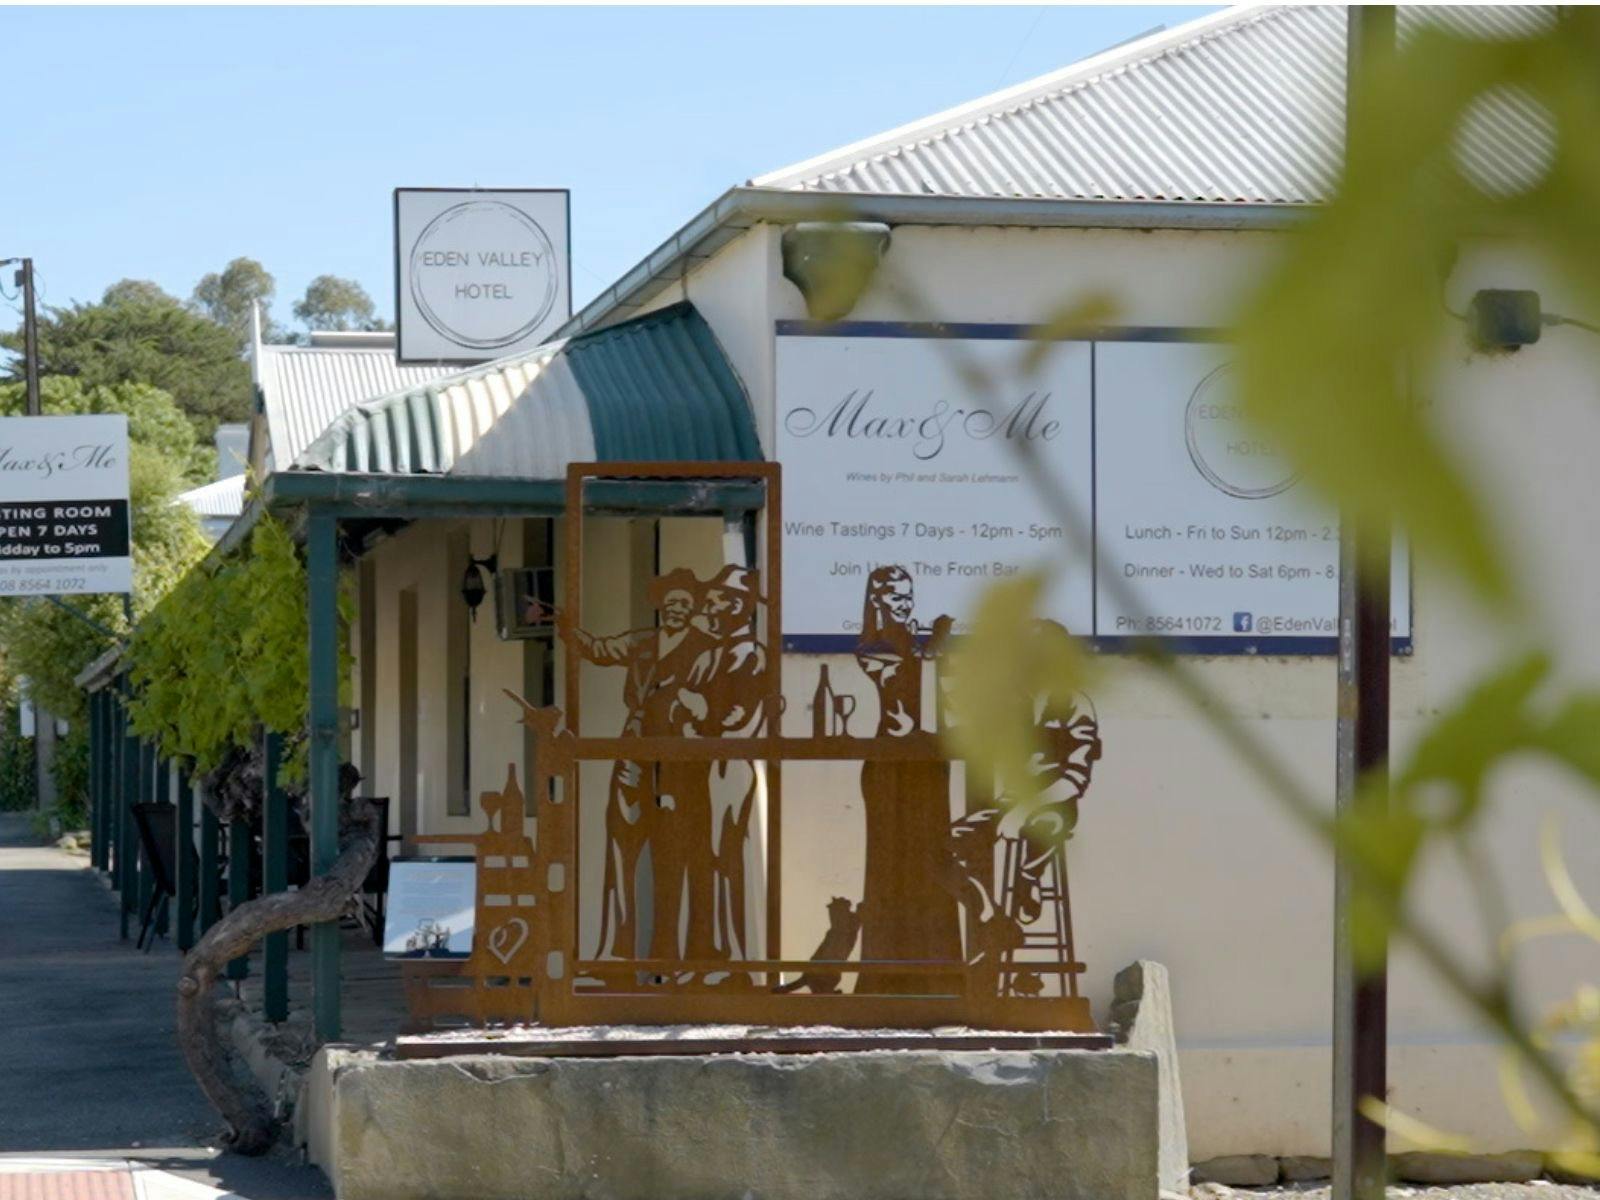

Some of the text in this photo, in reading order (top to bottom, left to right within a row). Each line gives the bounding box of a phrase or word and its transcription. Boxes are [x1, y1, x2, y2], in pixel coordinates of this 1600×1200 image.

[422, 251, 543, 267] EDEN VALLEY
[455, 284, 513, 300] HOTEL
[846, 472, 877, 482] Wines
[880, 473, 892, 484] by
[895, 472, 914, 482] Phil
[917, 473, 937, 482] and
[939, 473, 969, 483] Sarah
[0, 506, 112, 520] TING ROOM
[37, 525, 48, 537] 7
[53, 523, 98, 537] DAYS
[784, 521, 825, 537] Wine
[830, 521, 896, 541] Tastings
[901, 522, 910, 536] 7
[914, 522, 955, 541] Days
[971, 523, 1014, 541] 12pm
[1029, 524, 1062, 541] 5pm
[1124, 525, 1172, 540] Lunch
[1187, 525, 1207, 540] Fri
[1211, 527, 1226, 541] to
[1230, 525, 1260, 541] Sun
[1266, 526, 1308, 543] 12pm
[43, 544, 62, 555] to
[64, 542, 100, 555] 5pm
[829, 562, 862, 576] Join
[913, 561, 943, 576] The
[947, 562, 988, 577] Front
[992, 562, 1019, 577] Bar
[1124, 563, 1175, 578] Dinner
[1189, 564, 1224, 578] Wed
[1229, 565, 1244, 578] to
[1248, 564, 1273, 579] Sat
[1277, 565, 1311, 581] 6pm
[55, 578, 86, 590] 1072
[1145, 616, 1222, 631] 85641072
